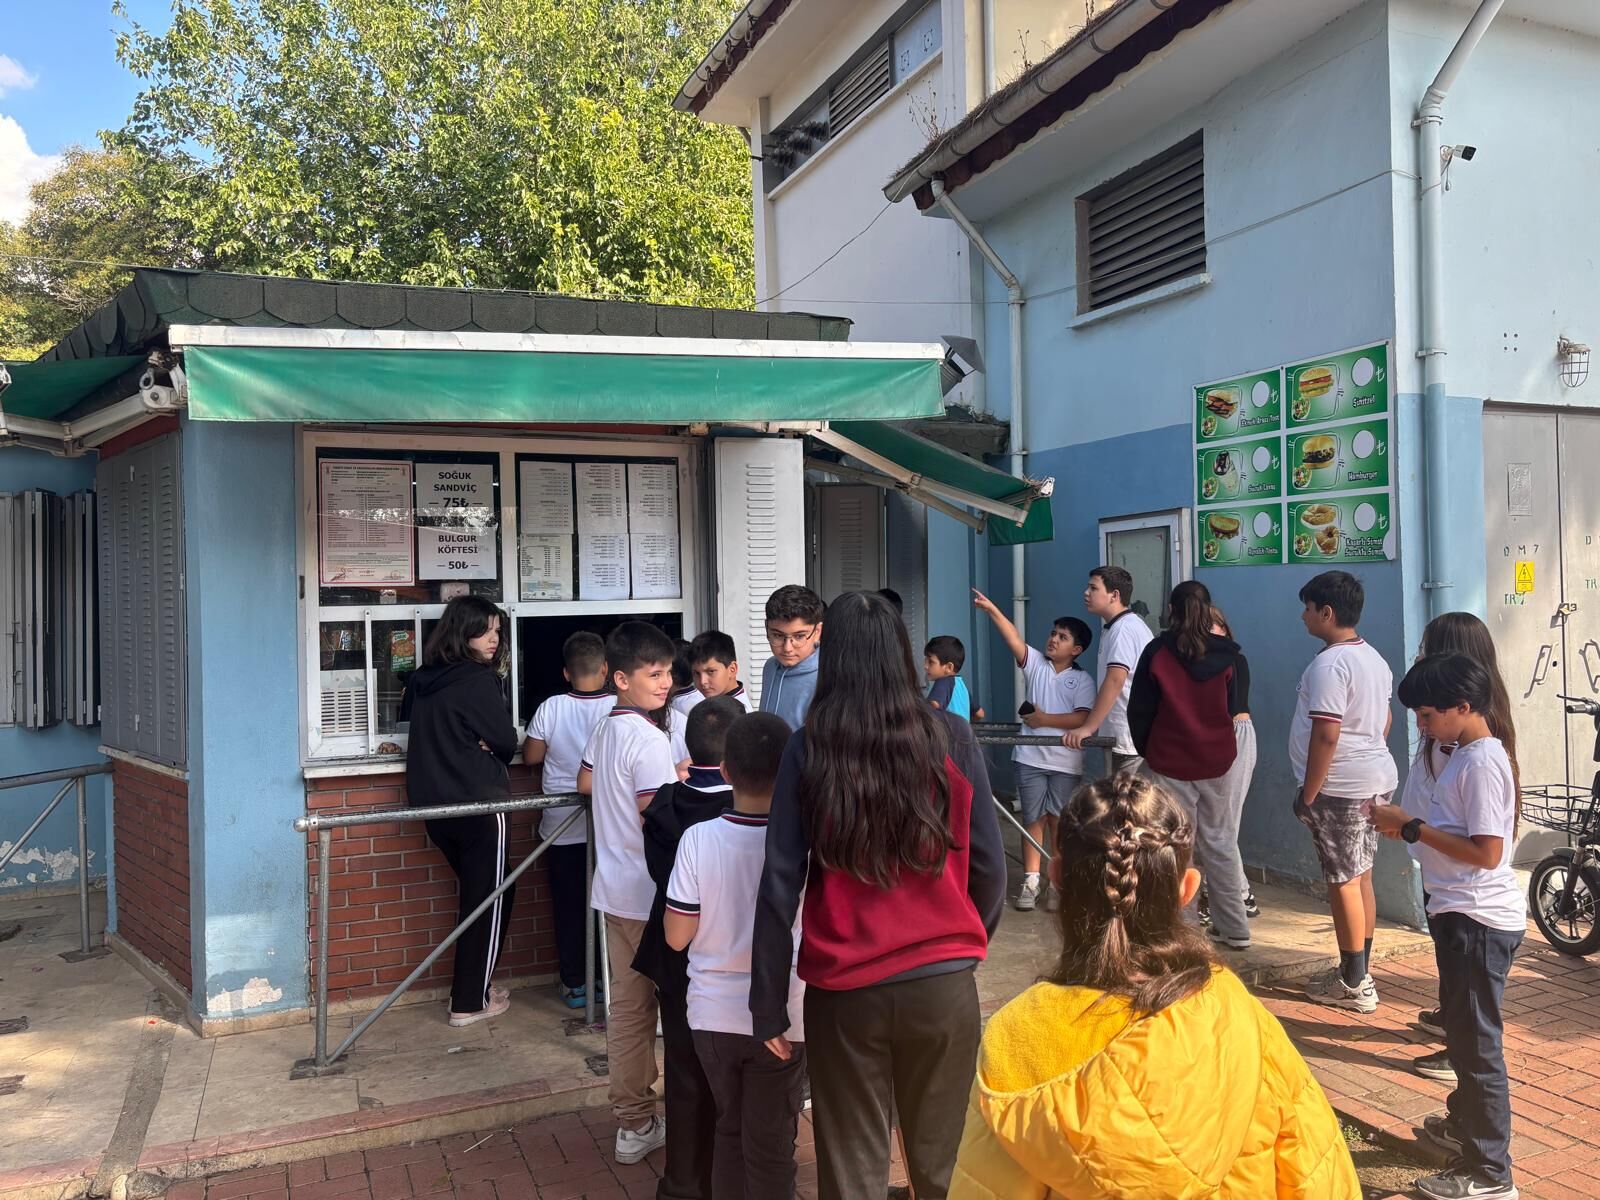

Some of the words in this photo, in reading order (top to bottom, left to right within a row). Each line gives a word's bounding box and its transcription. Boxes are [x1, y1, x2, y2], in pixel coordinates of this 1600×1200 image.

[438, 471, 472, 480] SOĞUK
[1348, 471, 1378, 481] Hamburger
[433, 483, 477, 493] SANDVİÇ
[443, 497, 469, 508] 75₺
[438, 535, 477, 543] BULGUR
[437, 545, 478, 554] KÖFTESİ
[448, 560, 469, 570] 50₺
